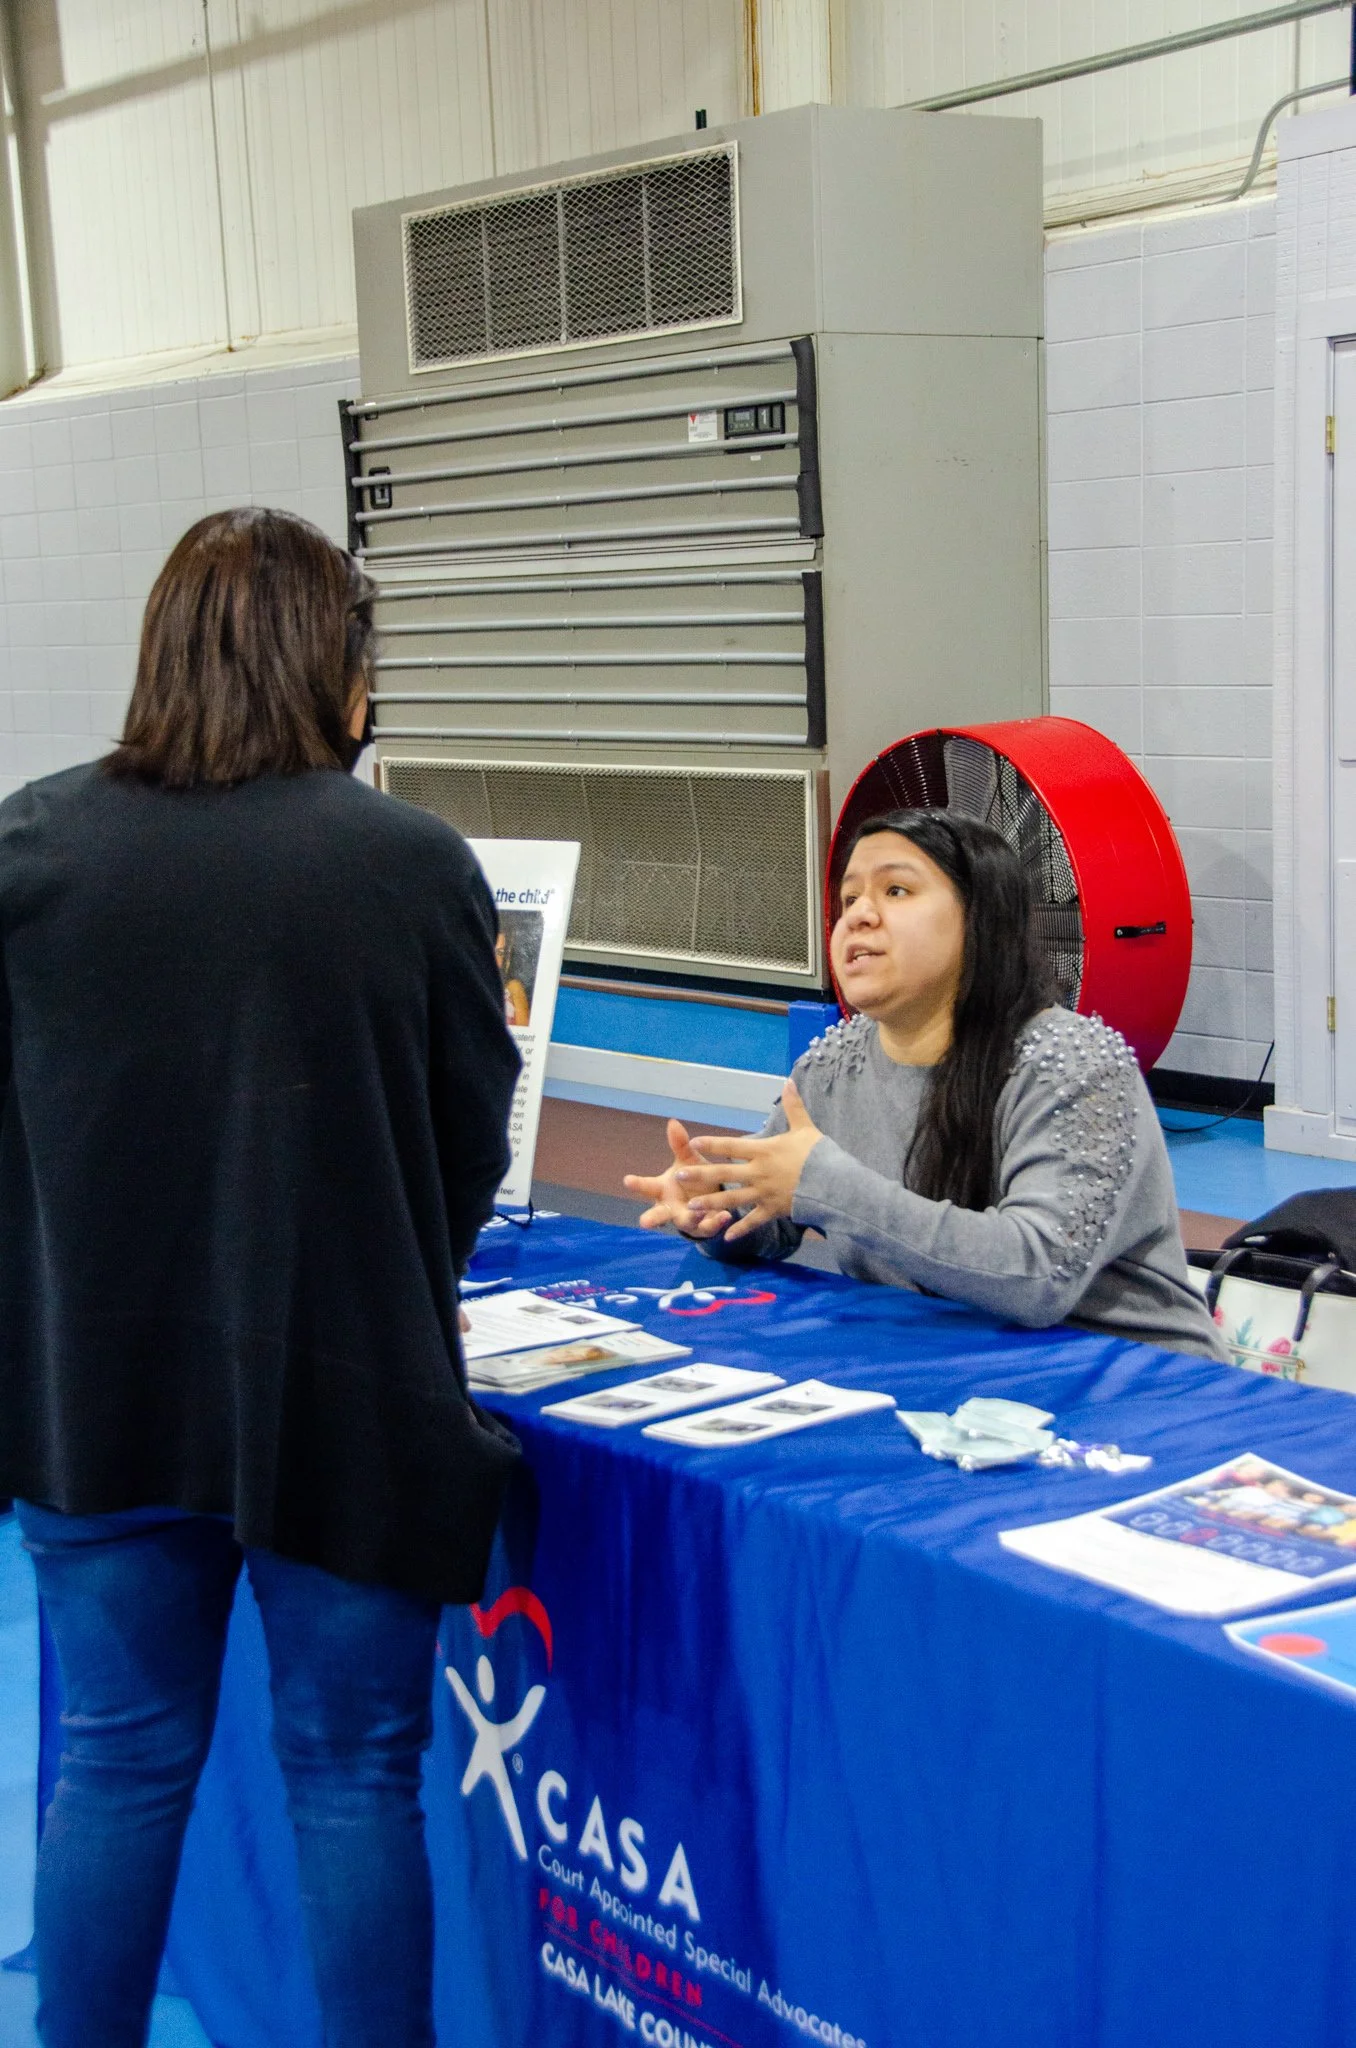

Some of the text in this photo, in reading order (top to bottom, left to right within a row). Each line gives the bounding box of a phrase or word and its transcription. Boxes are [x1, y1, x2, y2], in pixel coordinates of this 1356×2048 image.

[496, 888, 516, 903] the
[537, 1769, 701, 1923] CASA
[538, 1844, 867, 2048] Court Appointed Special Advocates
[539, 1887, 703, 2008] FOR CHILDREN
[541, 1942, 590, 1994] CASA
[594, 1974, 636, 2030] LAKE
